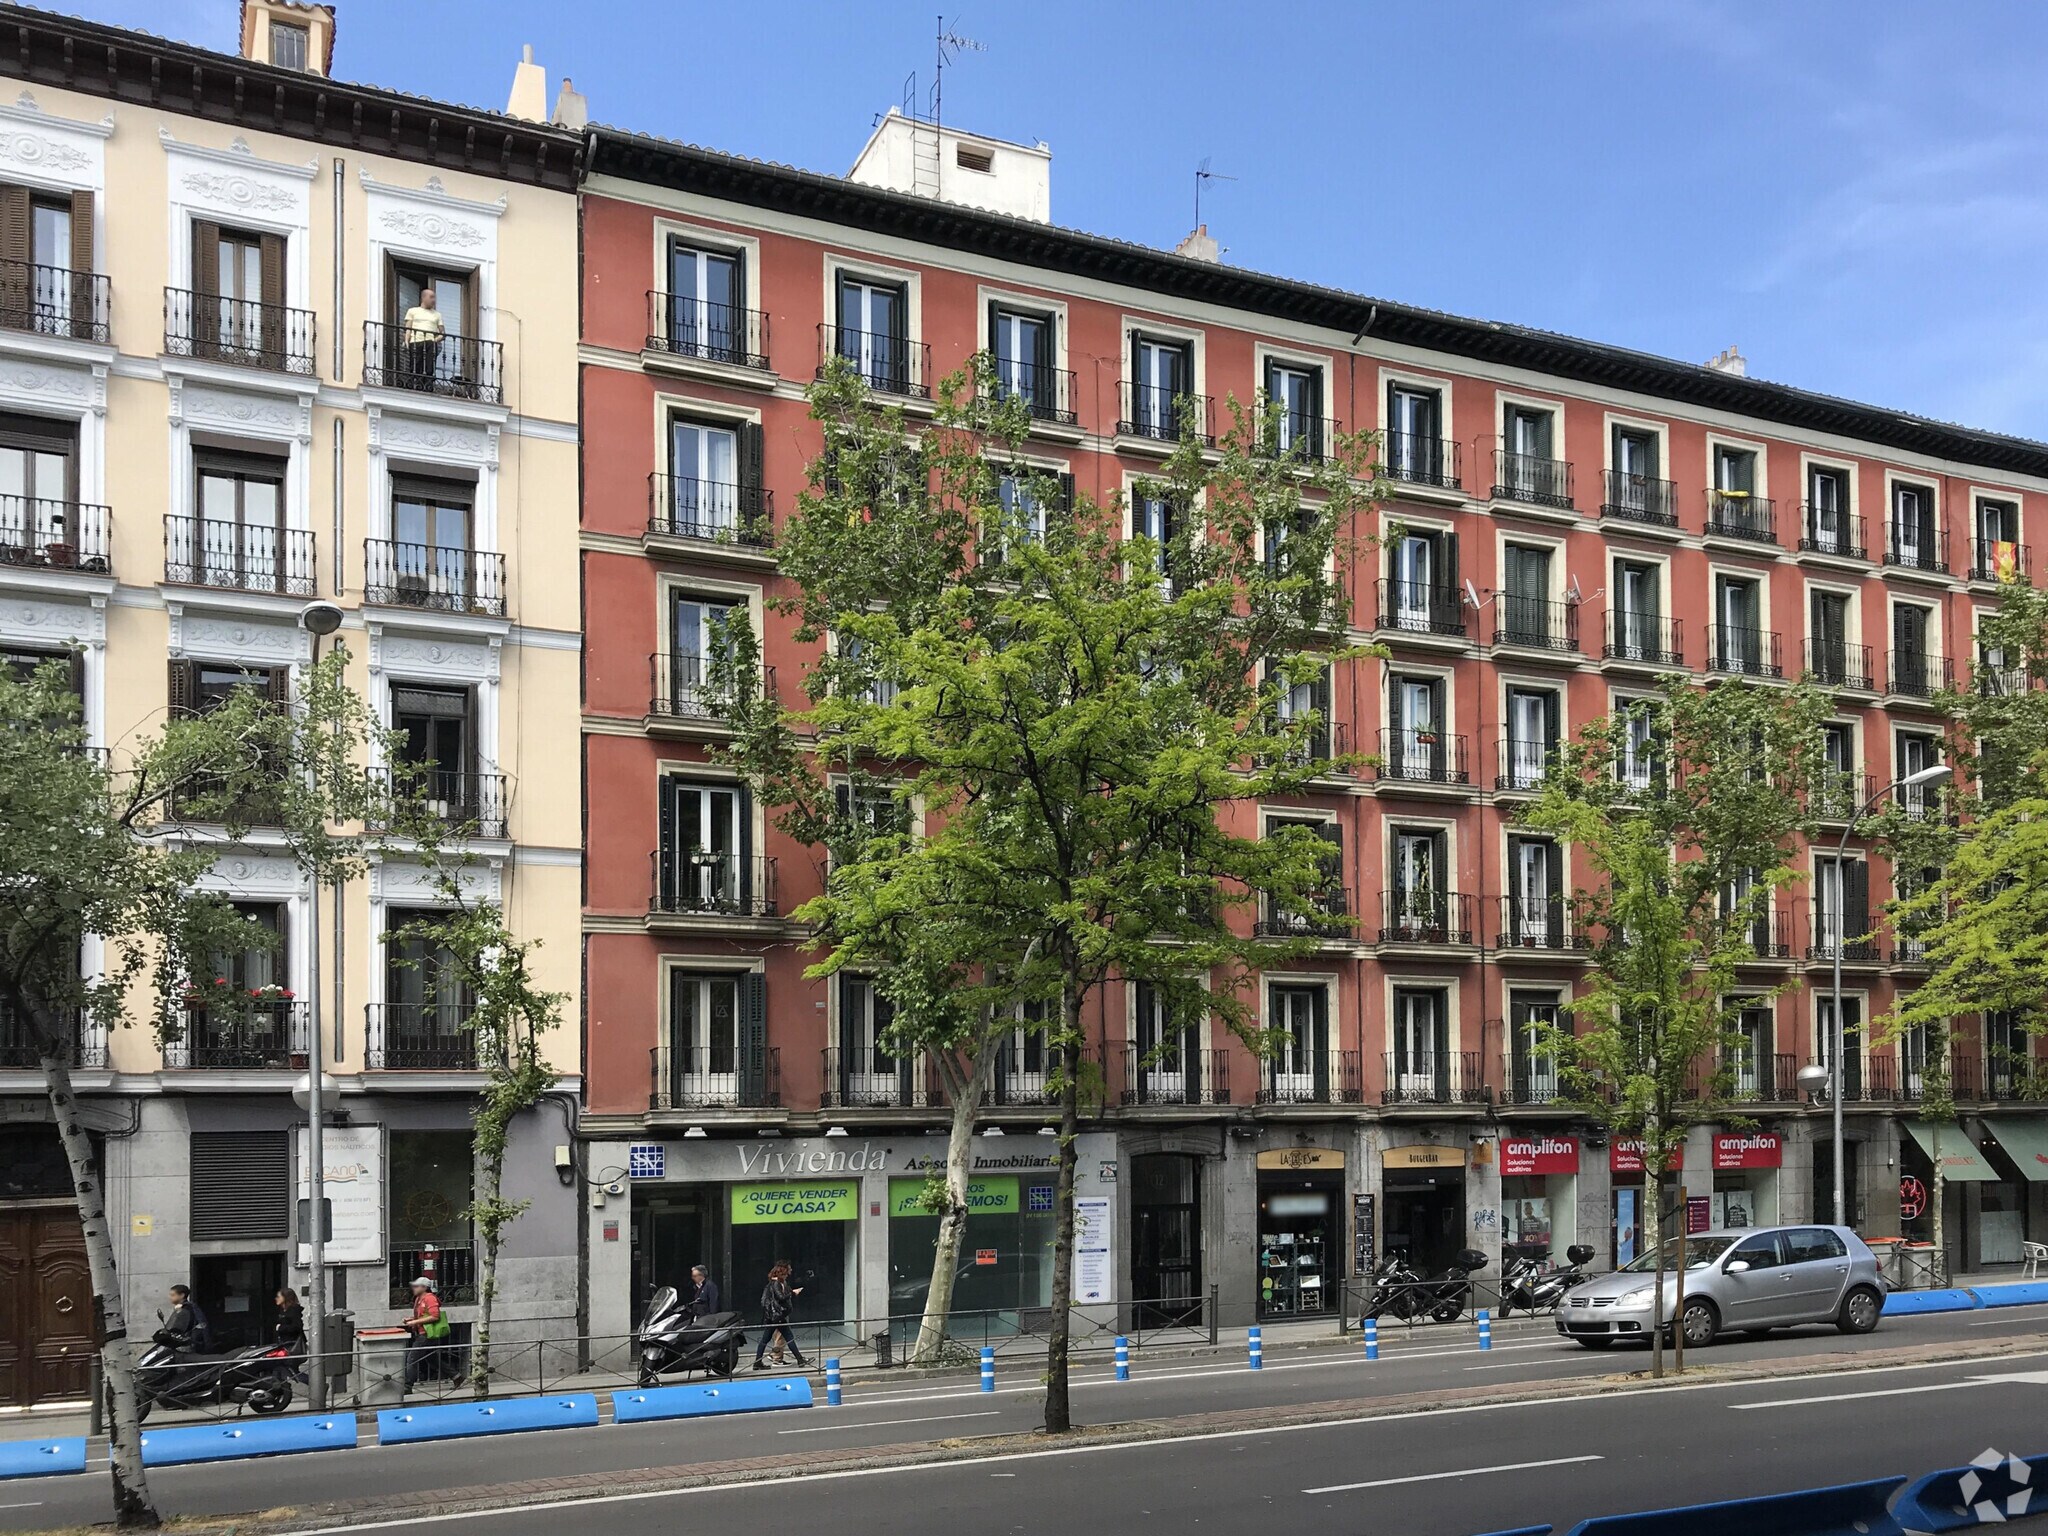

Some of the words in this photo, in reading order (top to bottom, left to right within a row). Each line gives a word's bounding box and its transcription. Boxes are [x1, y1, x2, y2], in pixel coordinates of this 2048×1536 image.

[1507, 1139, 1572, 1158] amplifon
[1720, 1135, 1776, 1152] amplifon
[736, 1141, 886, 1175] Vivienda
[904, 1158, 948, 1170] Aseso
[973, 1154, 1061, 1168] Inmobiliario
[305, 1165, 357, 1176] ECANO
[741, 1191, 796, 1204] ¿QUIERE
[799, 1189, 848, 1199] VENDER
[754, 1203, 778, 1216] SU
[782, 1201, 836, 1215] CASA?
